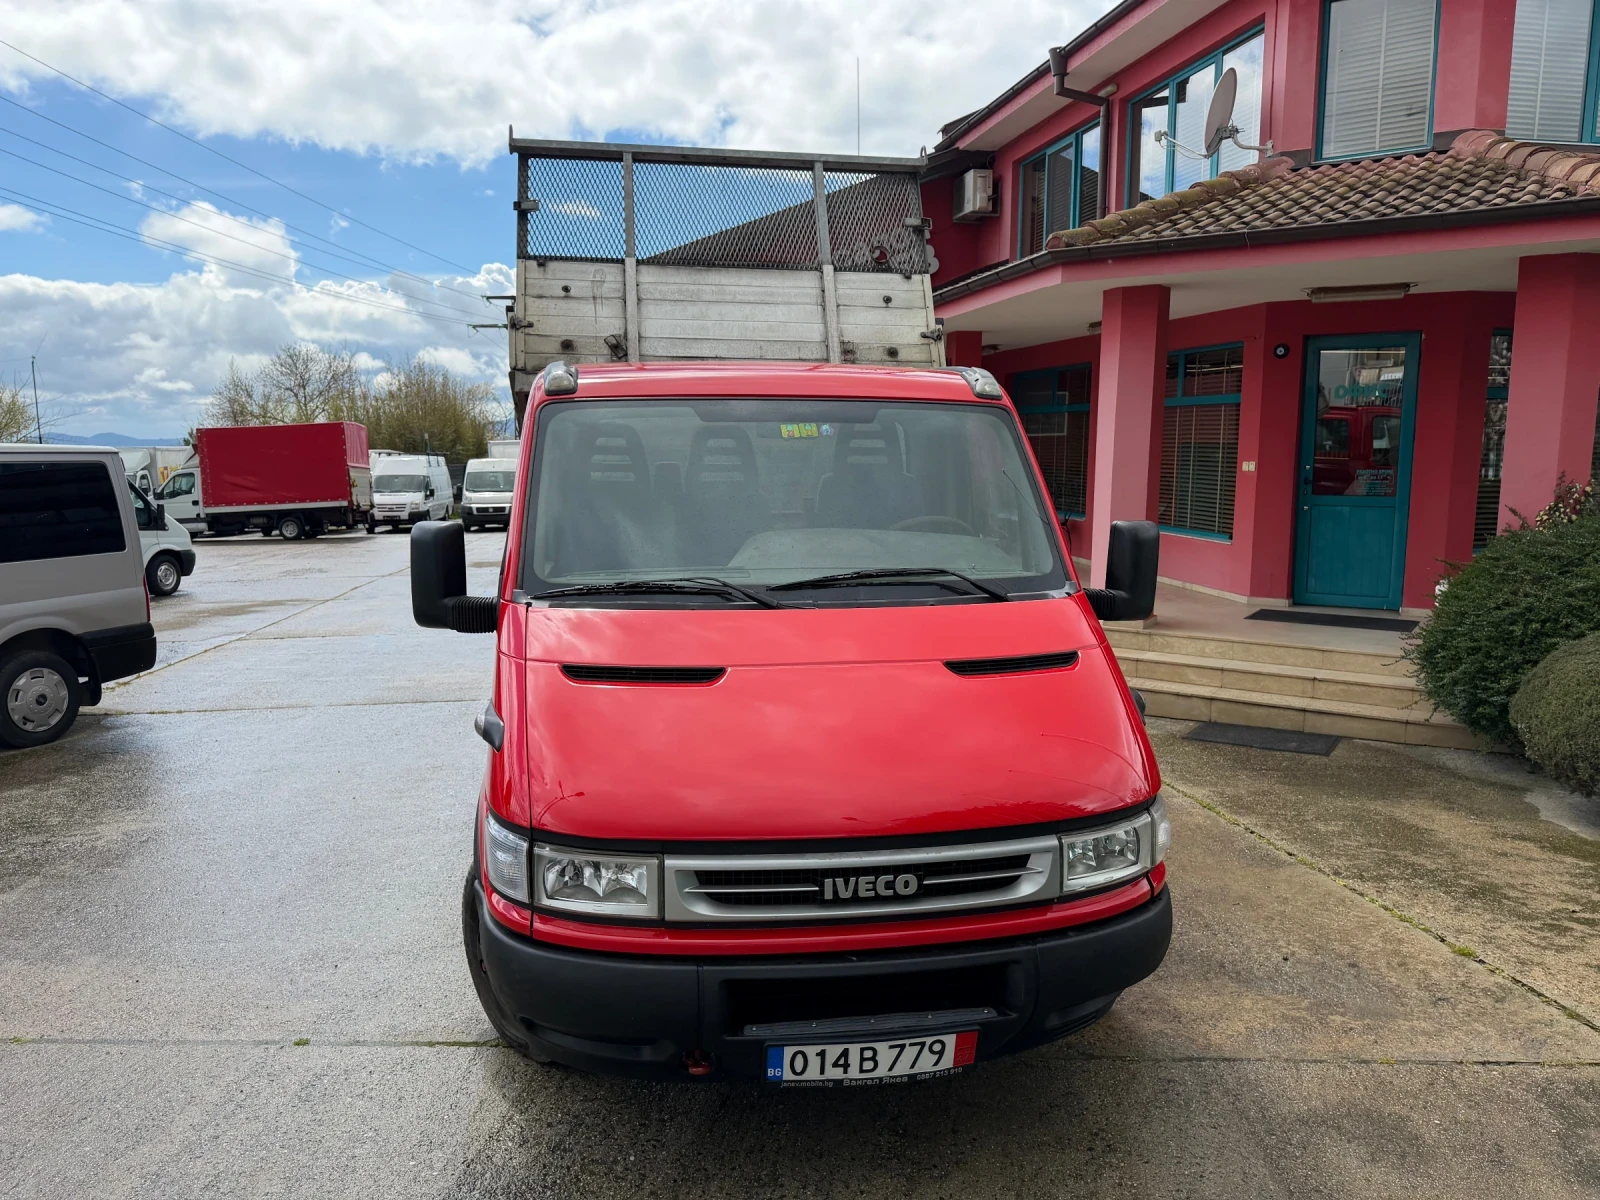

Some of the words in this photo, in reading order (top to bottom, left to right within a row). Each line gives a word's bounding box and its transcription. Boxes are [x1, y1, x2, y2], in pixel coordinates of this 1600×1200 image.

[824, 874, 919, 900] IVECO
[767, 1068, 782, 1077] BG
[882, 1076, 908, 1084] Янев
